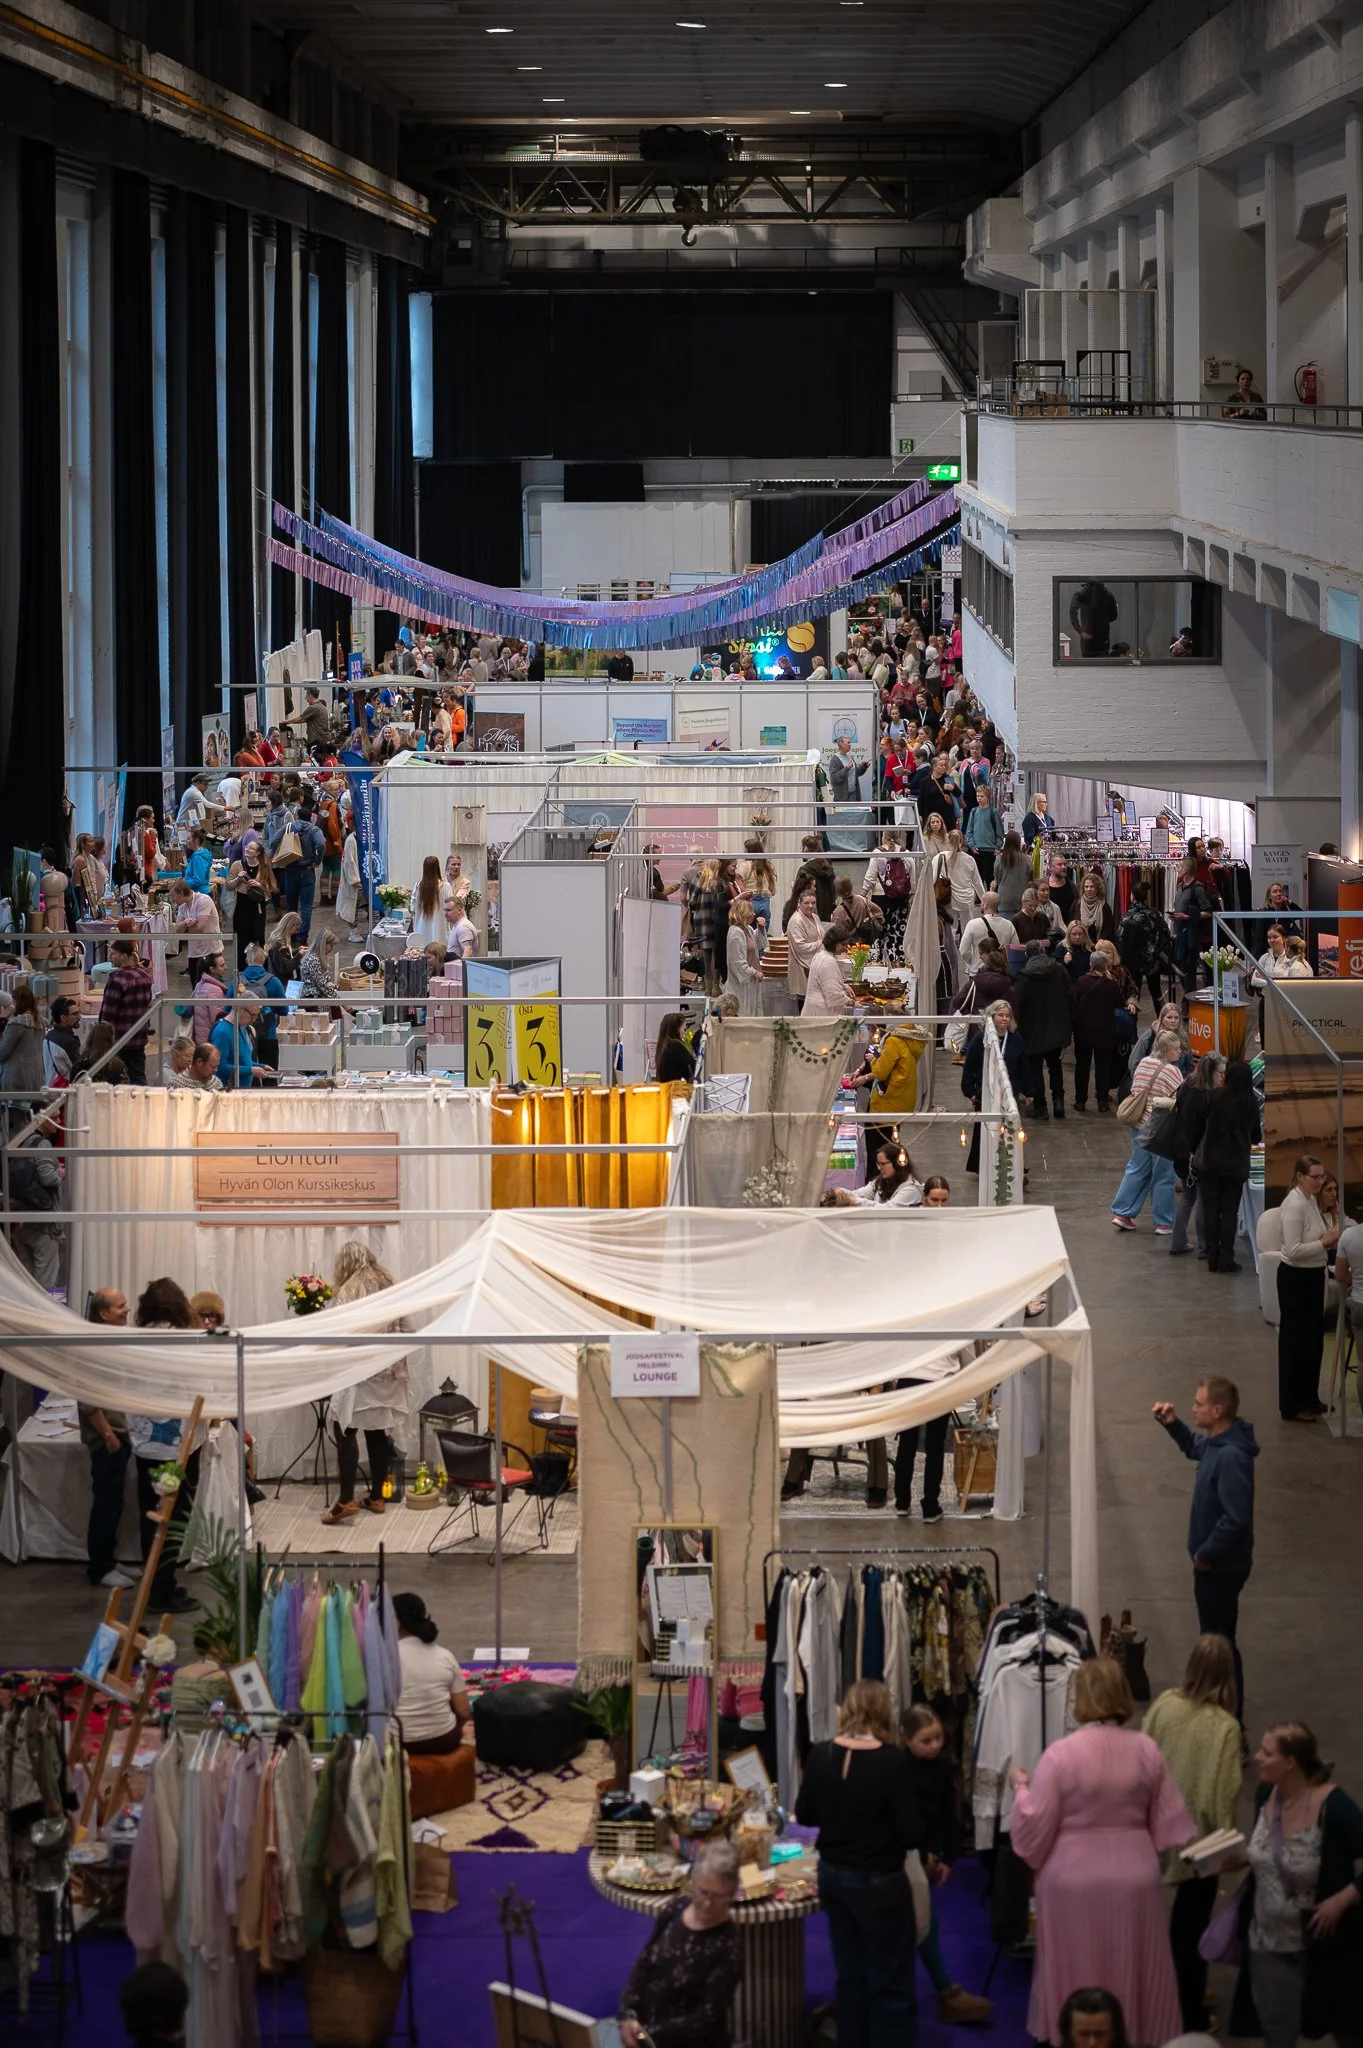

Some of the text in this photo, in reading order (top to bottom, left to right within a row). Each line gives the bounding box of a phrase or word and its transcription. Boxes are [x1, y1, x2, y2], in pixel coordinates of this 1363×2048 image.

[483, 727, 518, 742] Mervi
[1292, 1019, 1346, 1028] PRCTICAL
[219, 1177, 376, 1193] Hyvän Olon Kurssikeskus
[625, 1352, 684, 1360] JOOGAFESTIVAL
[633, 1372, 678, 1382] LOUNGE
